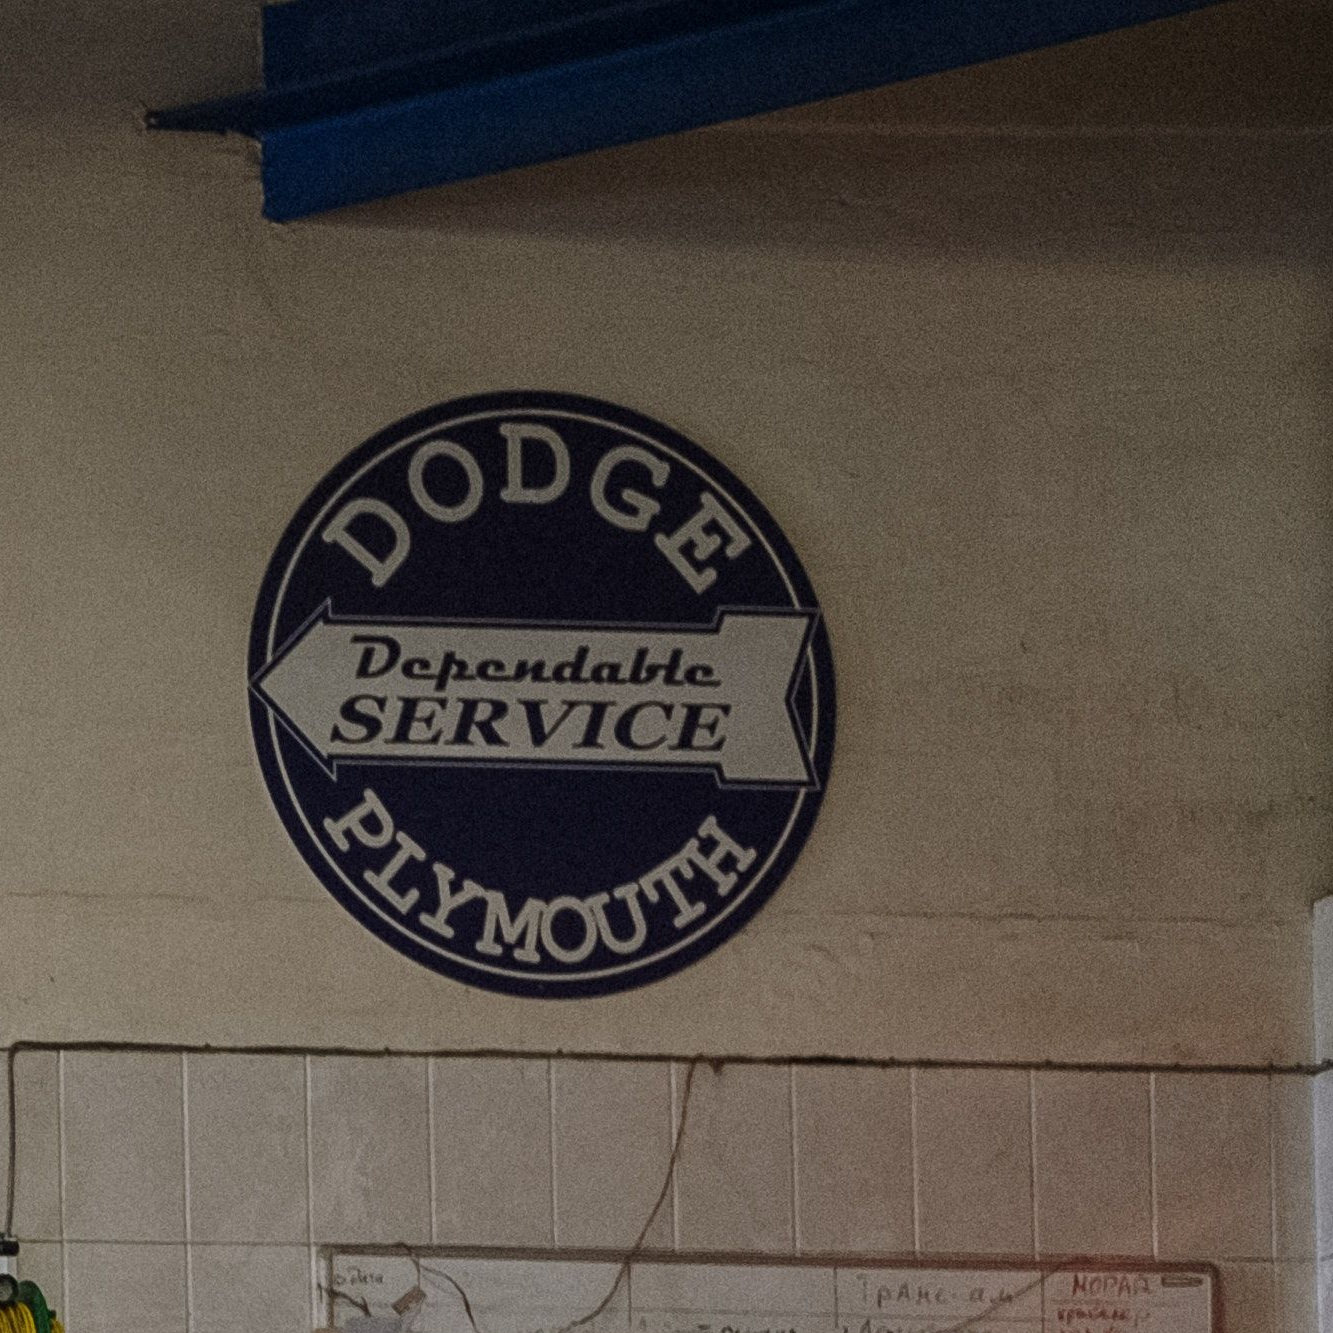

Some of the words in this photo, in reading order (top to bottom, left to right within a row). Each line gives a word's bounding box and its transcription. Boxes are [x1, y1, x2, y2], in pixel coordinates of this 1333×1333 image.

[322, 422, 752, 595] DODGE
[350, 634, 722, 691] Dependable
[329, 694, 730, 752] SERVICE
[323, 788, 757, 963] PLYMOUTH
